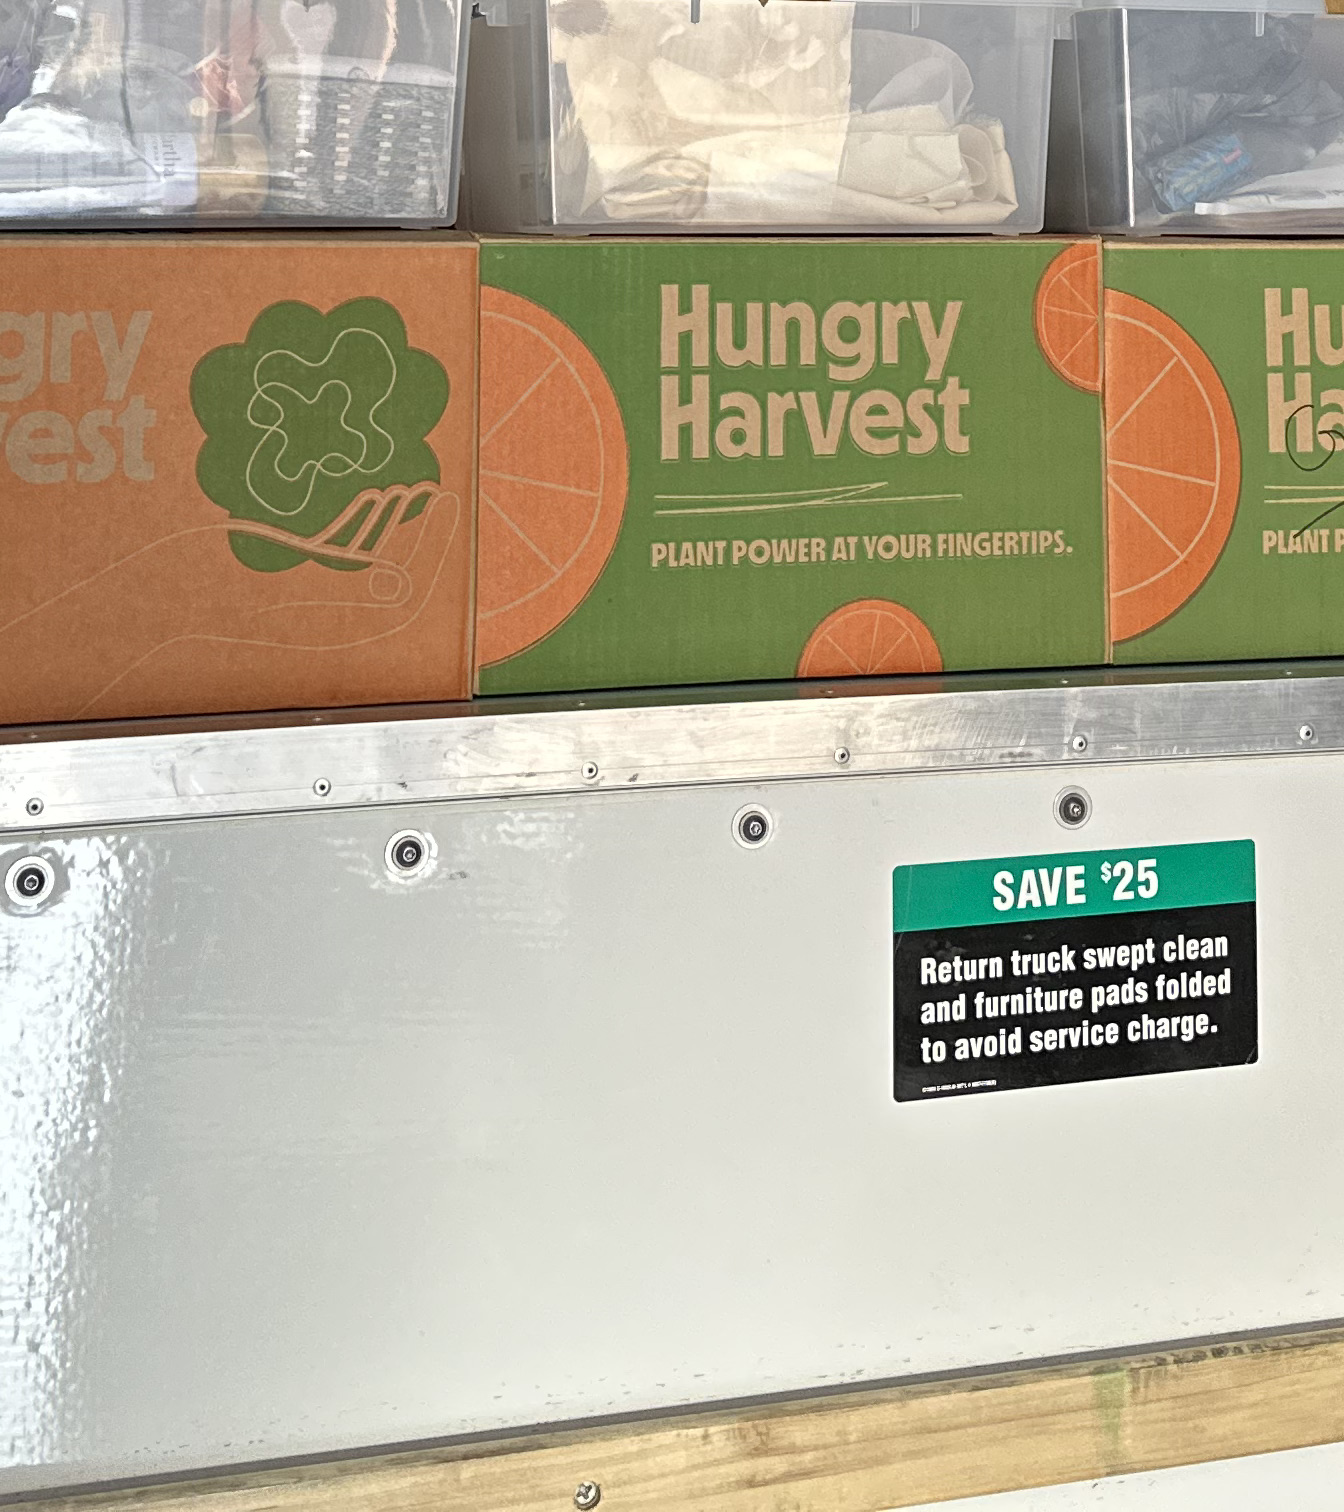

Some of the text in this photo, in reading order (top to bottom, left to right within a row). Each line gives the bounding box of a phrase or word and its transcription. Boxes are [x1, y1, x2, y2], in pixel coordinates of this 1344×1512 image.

[660, 284, 963, 382] Hungry
[660, 374, 971, 461] Harvest
[650, 529, 1074, 568] PLANT POWER AT YOUR FINGERTIPS.
[1262, 529, 1329, 555] PLANT
[992, 858, 1159, 912] SAVE $25
[920, 933, 1229, 985] Return truck swept clean
[920, 968, 1232, 1025] and furniture pads folded
[920, 1012, 1219, 1064] to avoid service charge.
